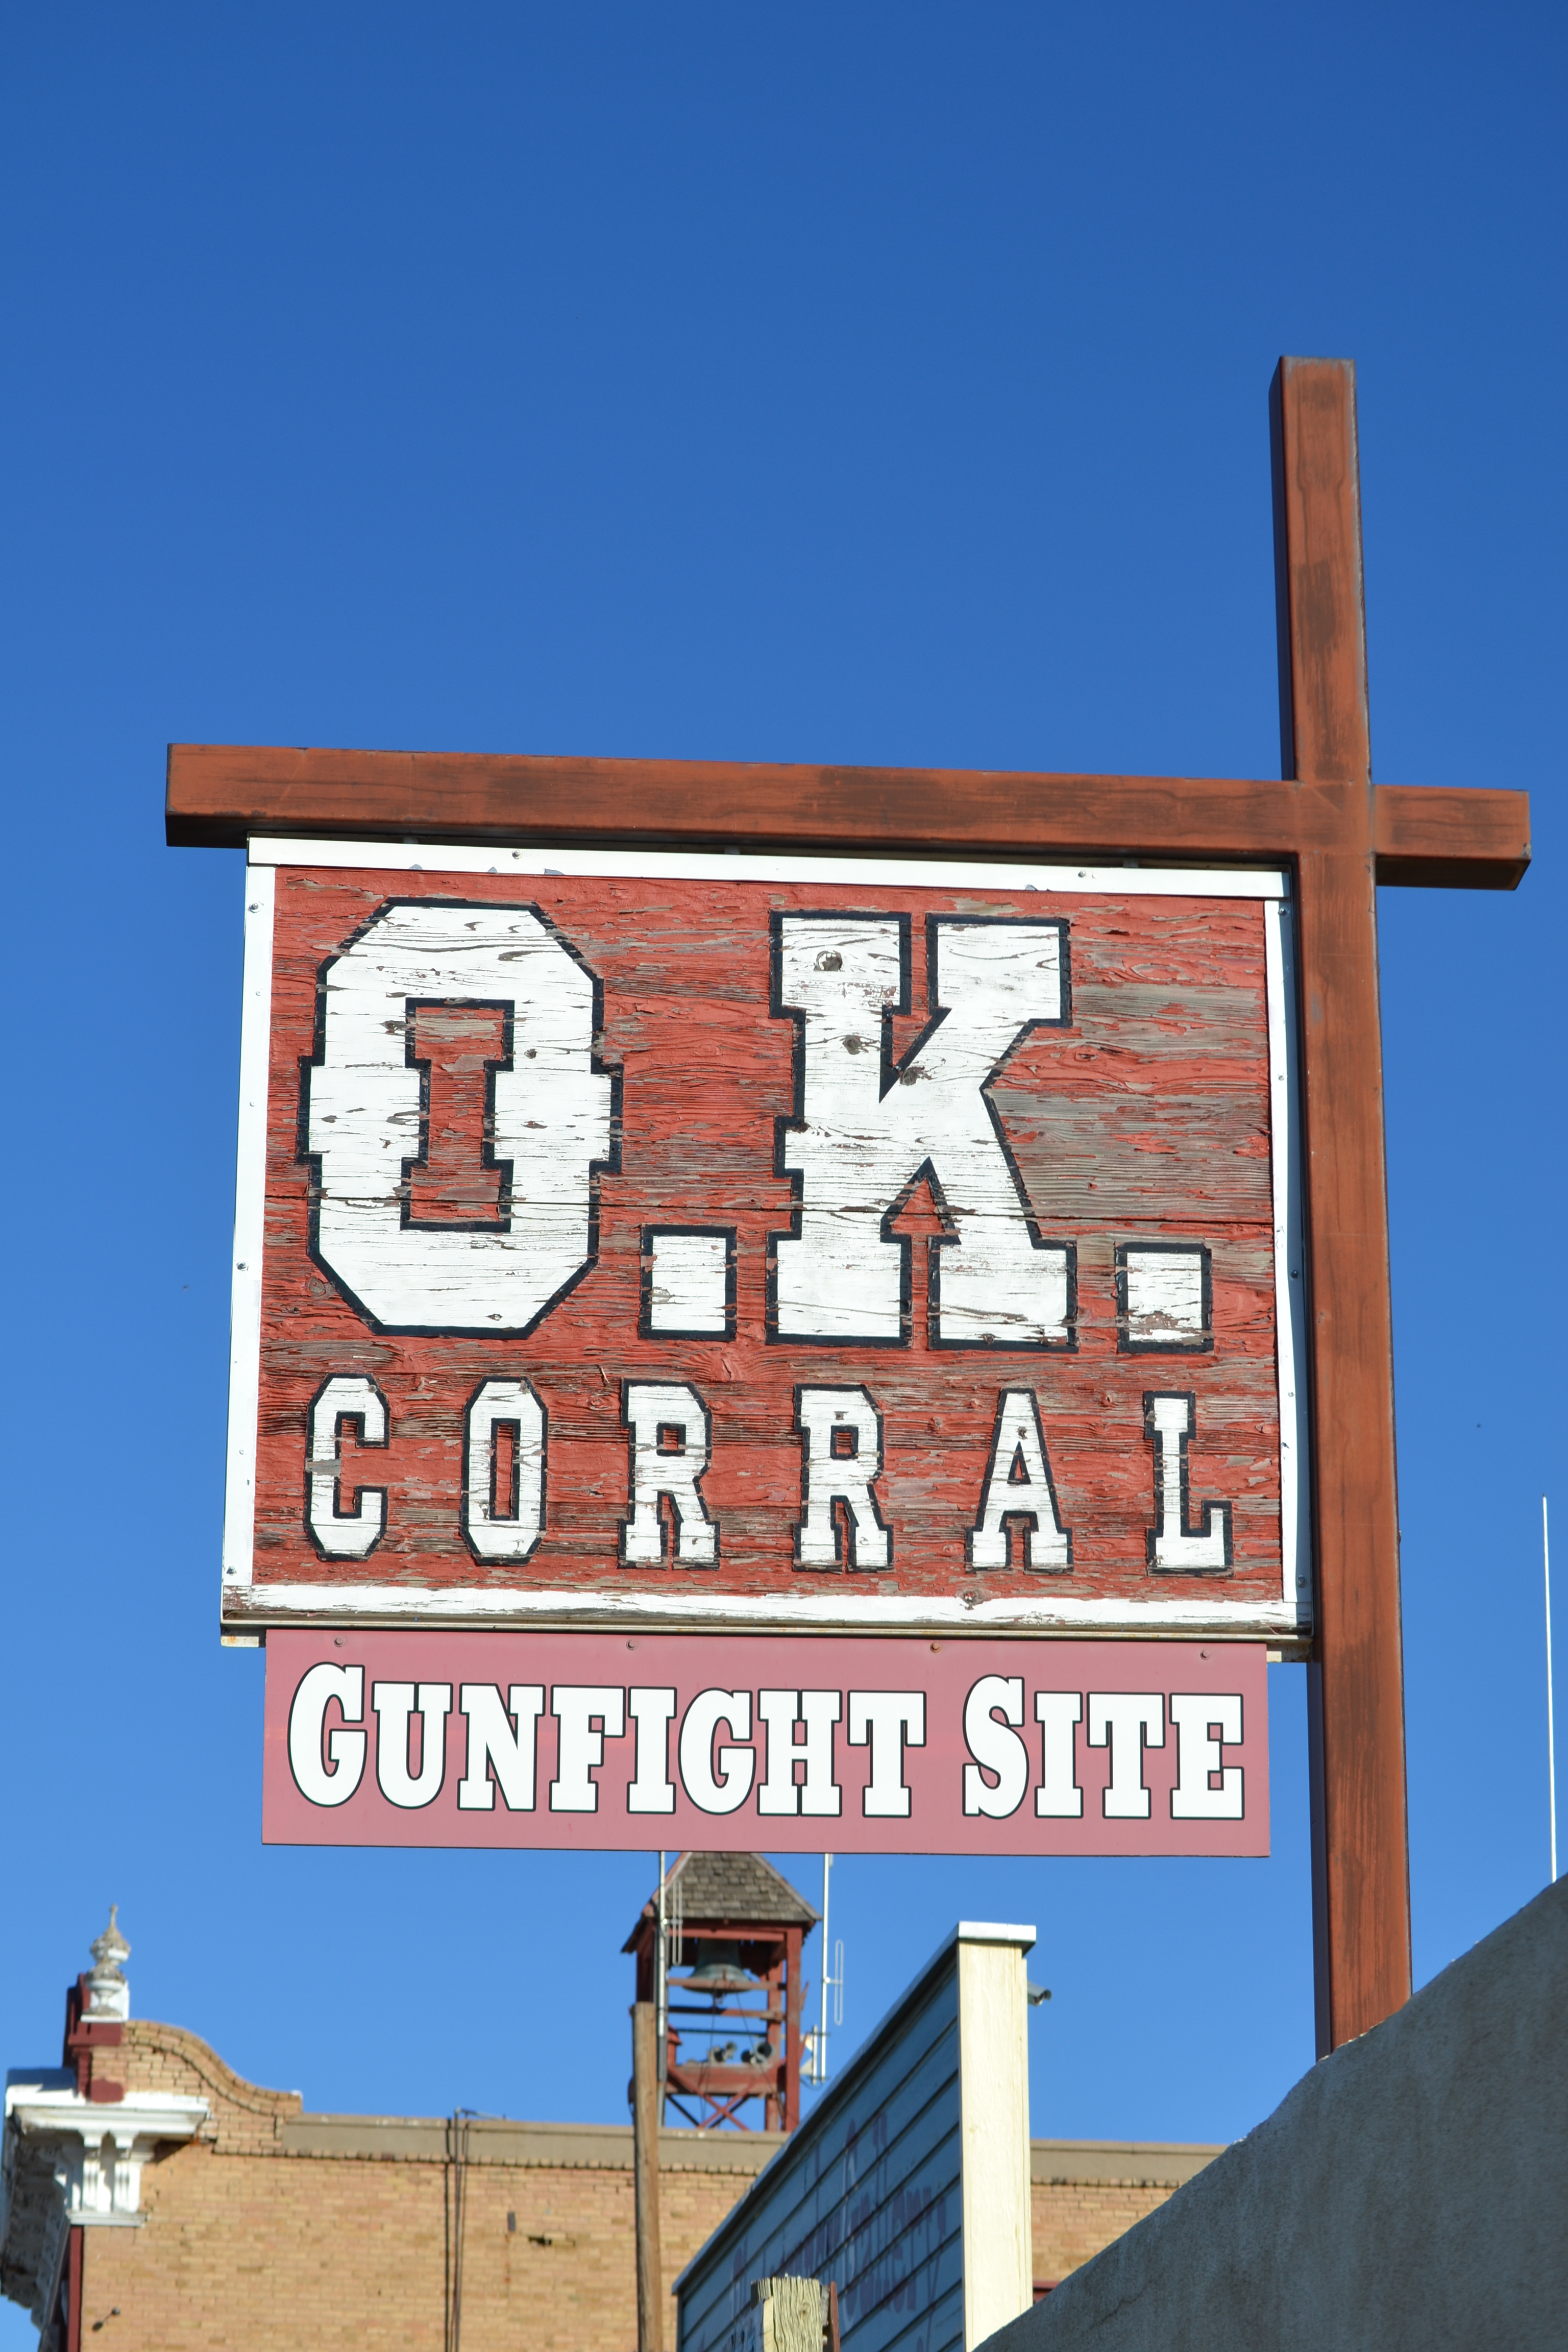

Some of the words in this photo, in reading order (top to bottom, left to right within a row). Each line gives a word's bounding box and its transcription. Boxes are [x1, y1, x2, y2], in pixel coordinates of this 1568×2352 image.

[297, 897, 1213, 1354] O.K.
[304, 1372, 1233, 1577] CORRAL
[287, 1661, 927, 1818] GUNFIGHT
[963, 1674, 1244, 1820] SITE
